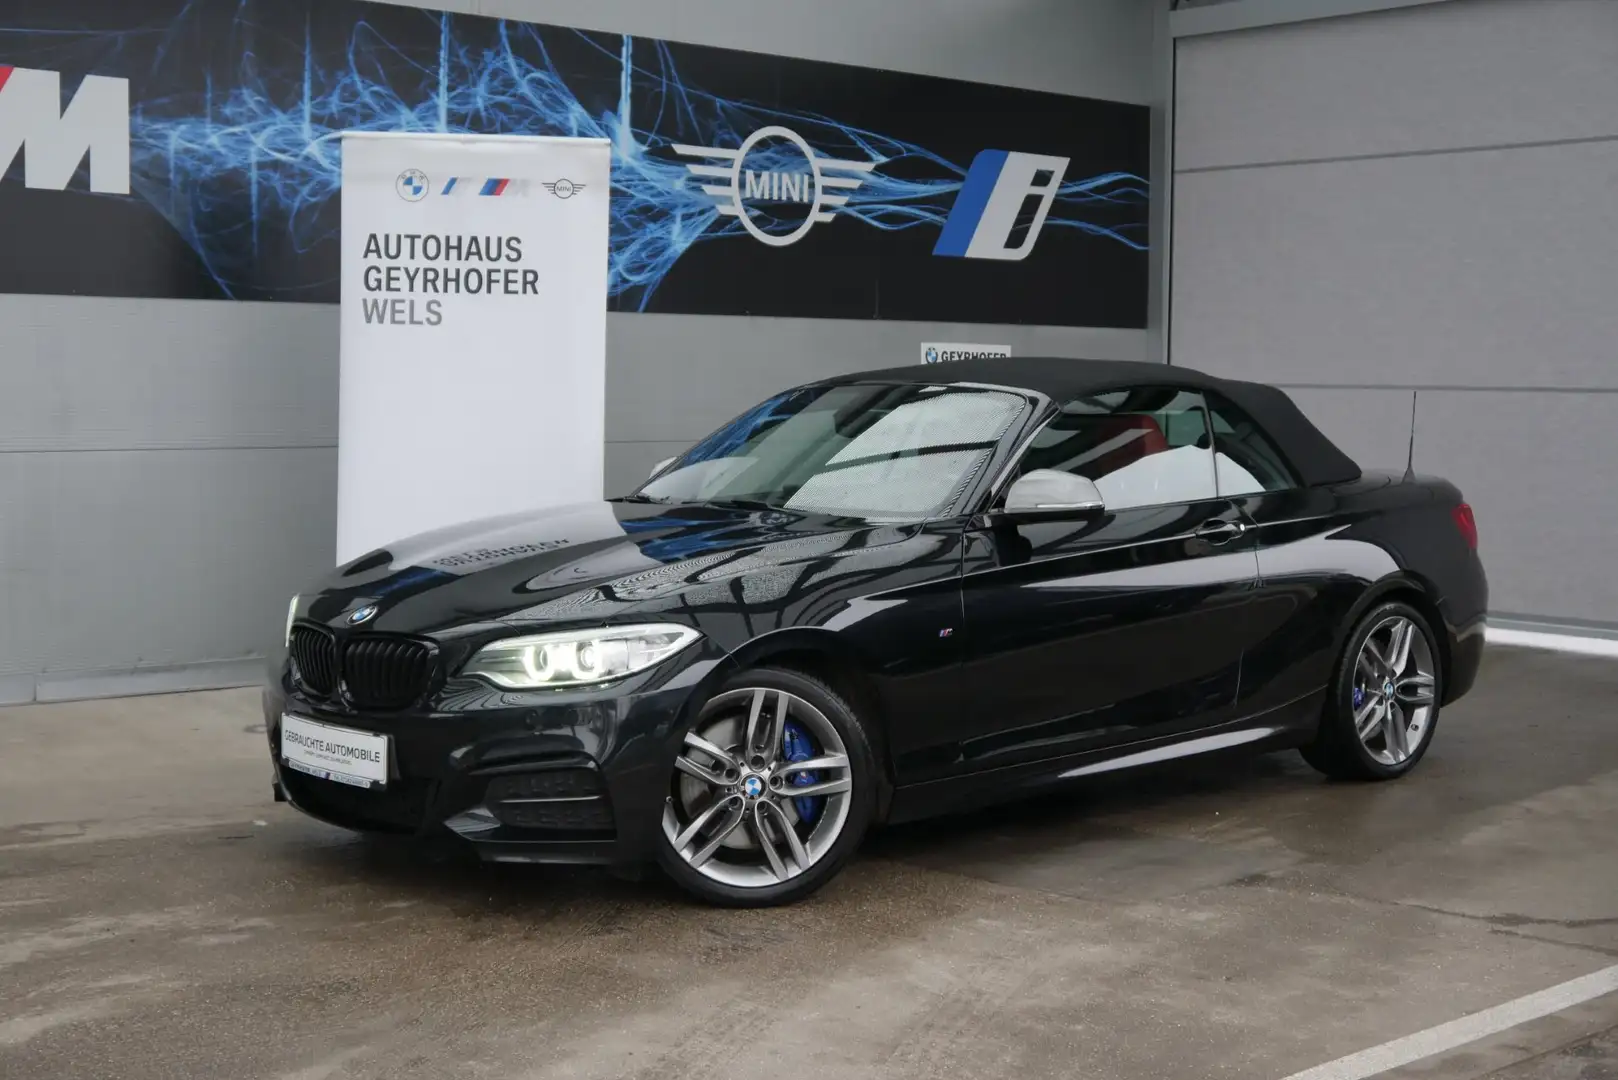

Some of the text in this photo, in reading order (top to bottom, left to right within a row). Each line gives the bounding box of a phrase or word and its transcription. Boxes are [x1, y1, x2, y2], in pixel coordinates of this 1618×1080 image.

[0, 66, 130, 195] M
[745, 168, 809, 203] MINI
[362, 232, 523, 263] AUTOHAUS
[363, 264, 540, 296] GEYRHOFER
[362, 297, 443, 326] WELS
[284, 729, 324, 752] GEBRAUCHTE
[325, 742, 381, 763] AUTOMOBILE
